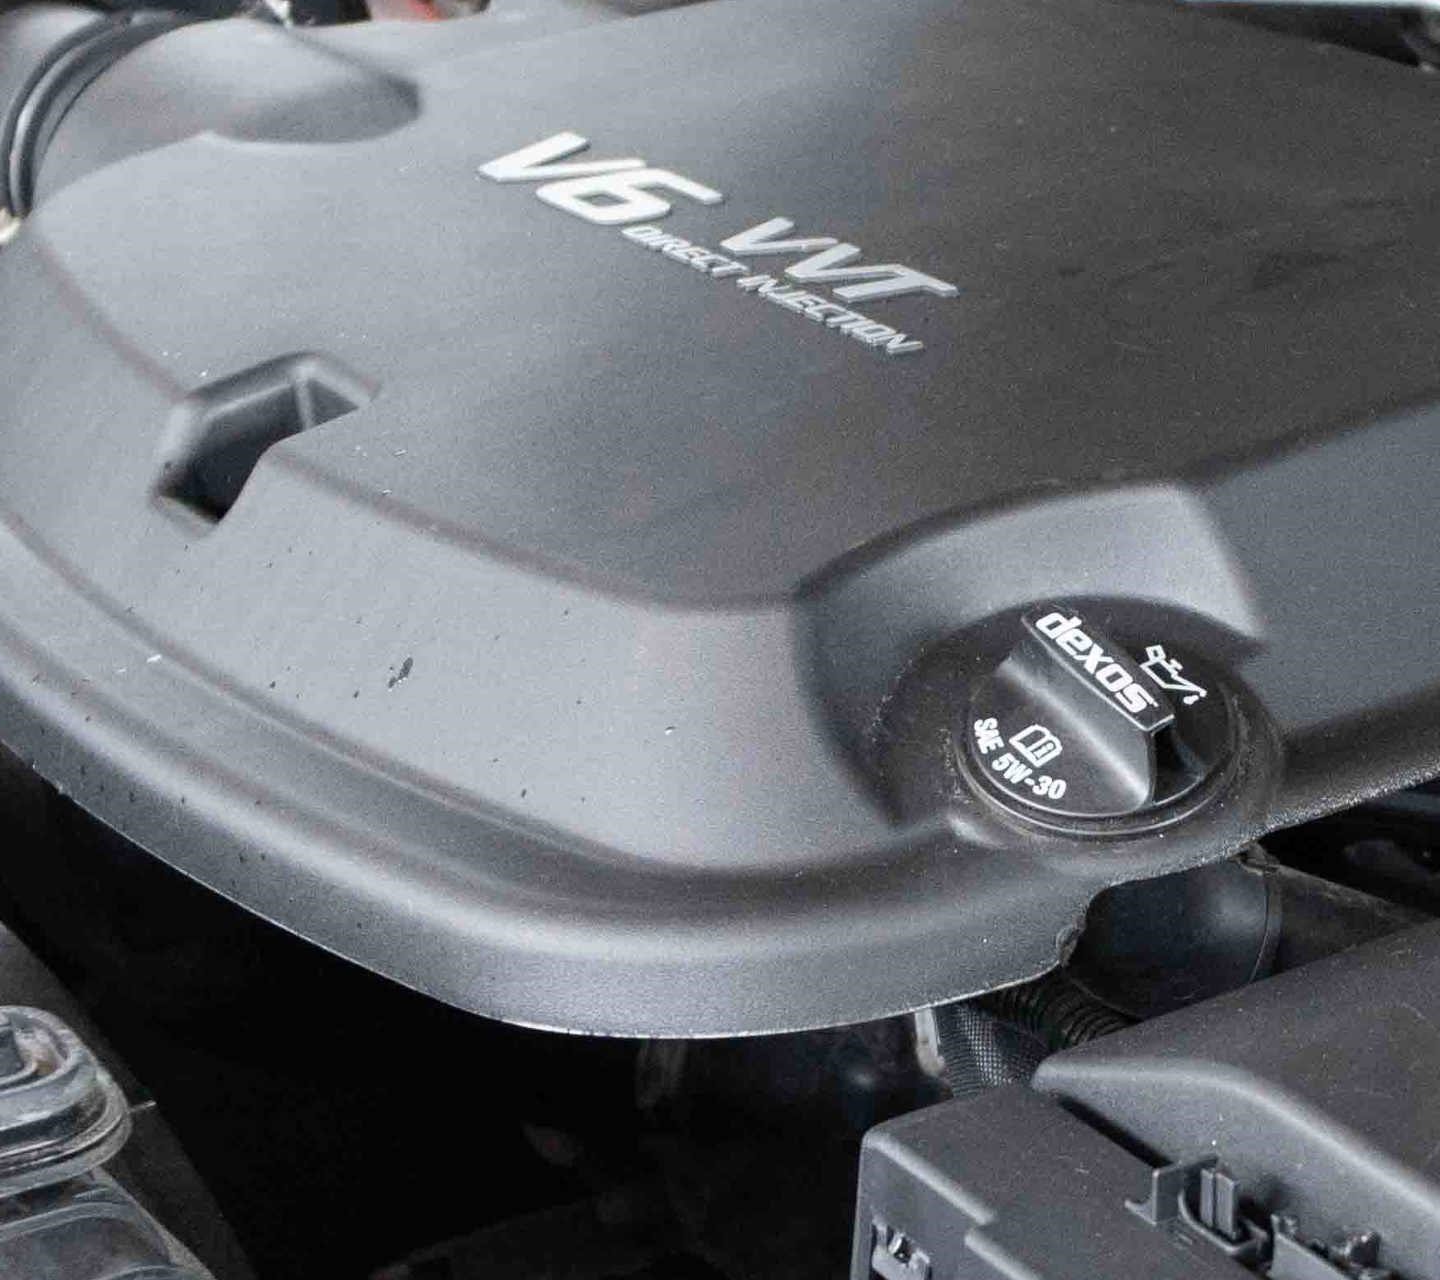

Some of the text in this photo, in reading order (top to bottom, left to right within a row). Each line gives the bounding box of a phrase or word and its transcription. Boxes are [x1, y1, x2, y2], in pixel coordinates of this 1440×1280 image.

[477, 131, 724, 225] V6
[620, 225, 926, 356] DIRECT INJECTION
[1035, 611, 1160, 714] dexos
[973, 717, 1067, 801] SAE 5W-30
